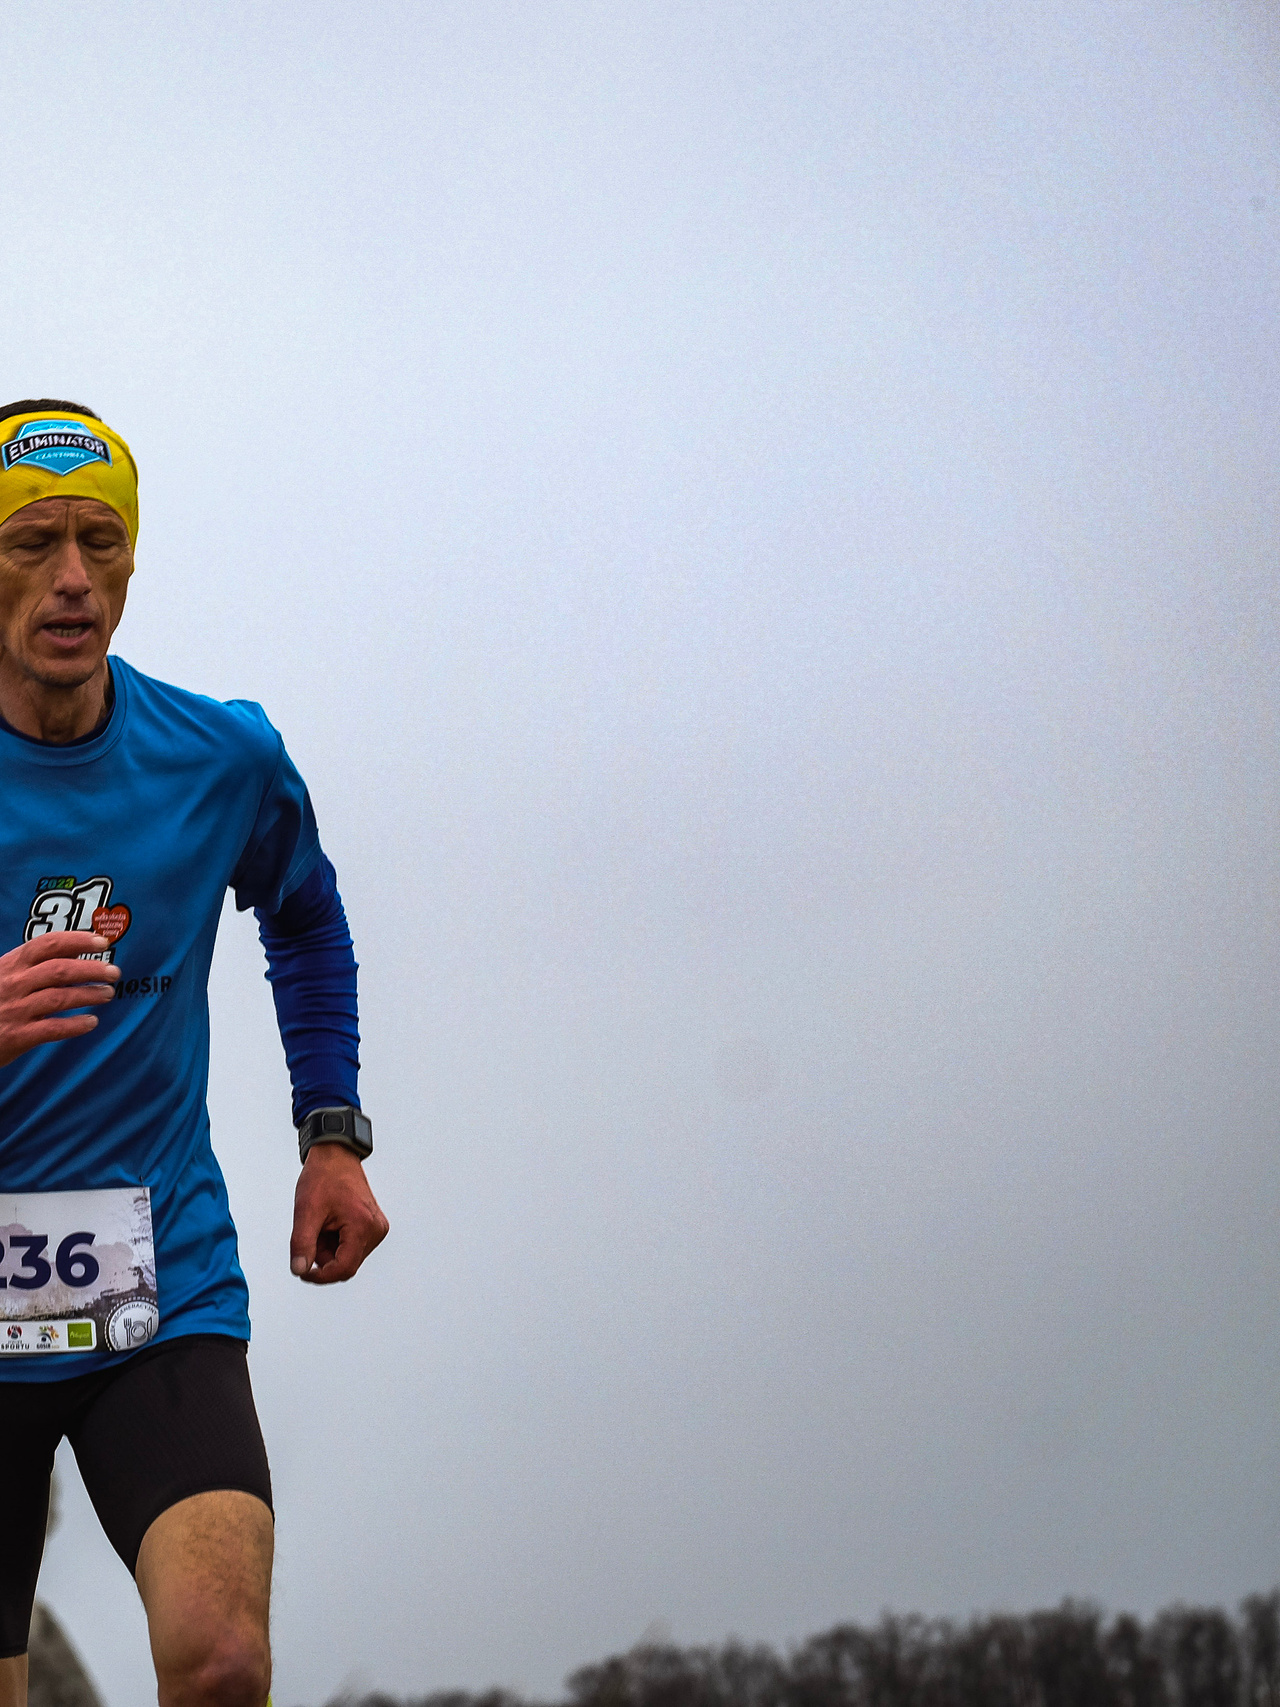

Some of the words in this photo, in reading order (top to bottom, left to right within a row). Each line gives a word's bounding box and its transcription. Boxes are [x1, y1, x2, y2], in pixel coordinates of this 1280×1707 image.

[9, 435, 106, 460] ELIMINATOR
[39, 877, 75, 890] 2023
[26, 879, 109, 941] 31
[1, 1343, 30, 1351] SPORTU
